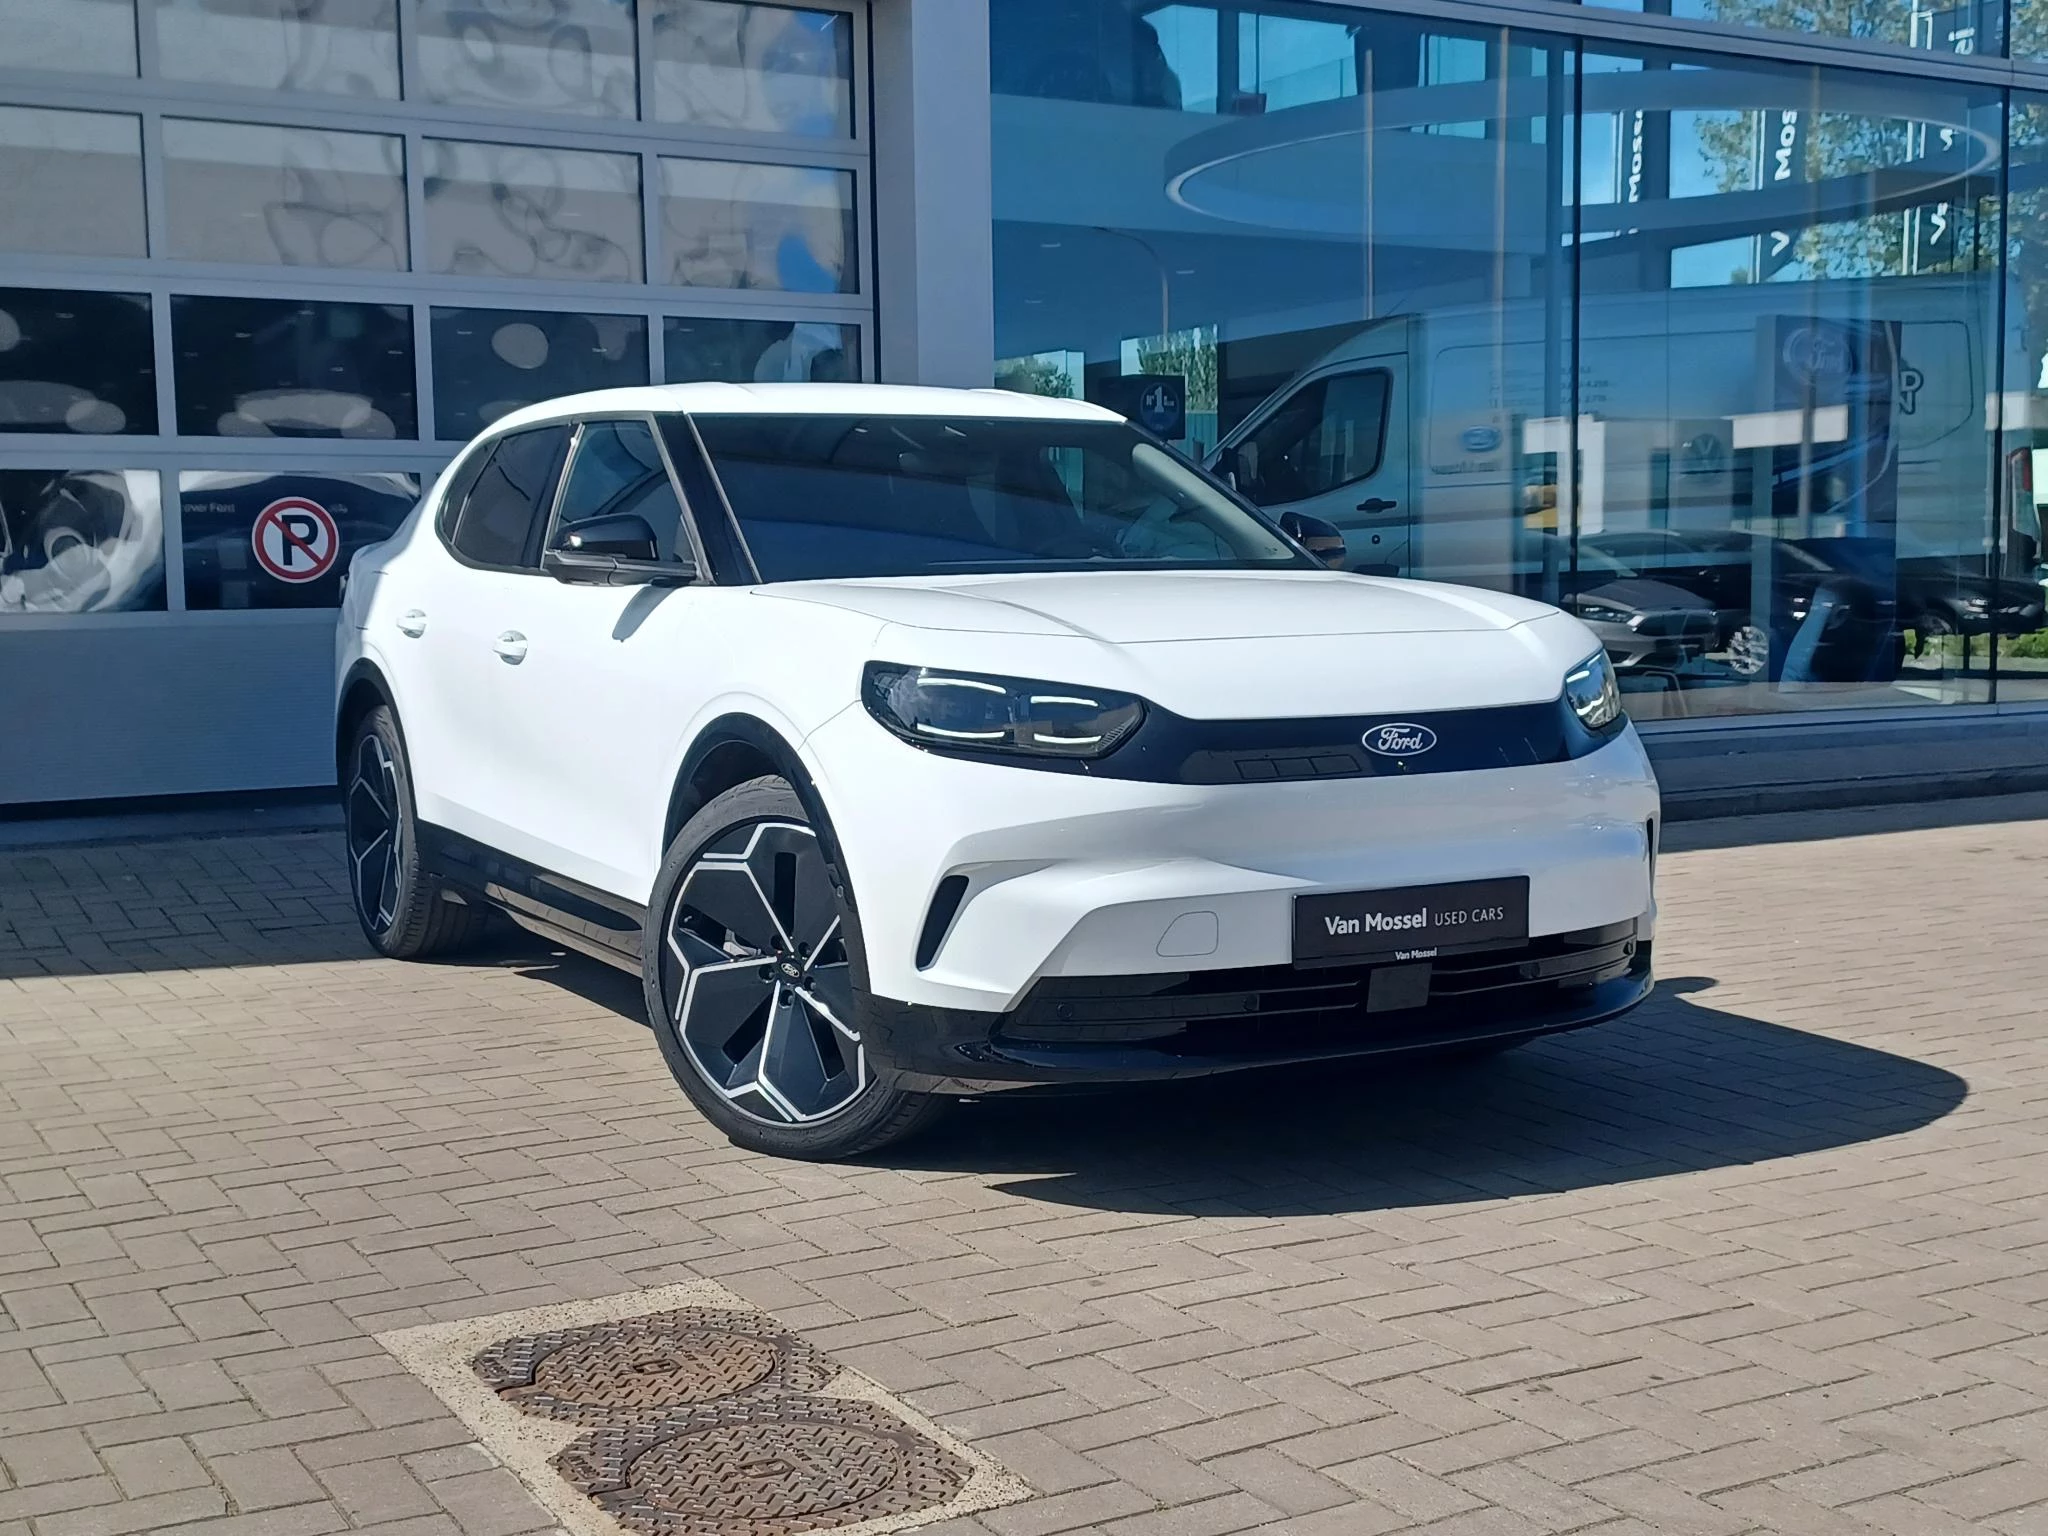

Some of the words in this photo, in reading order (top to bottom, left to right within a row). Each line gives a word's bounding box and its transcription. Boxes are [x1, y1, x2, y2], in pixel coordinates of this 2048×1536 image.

[281, 514, 319, 566] P
[1378, 727, 1423, 750] Ford
[1324, 916, 1360, 936] Van
[1365, 907, 1427, 932] Mossel
[1434, 911, 1468, 926] USED
[1472, 906, 1504, 922] CARS
[1395, 950, 1410, 960] Van
[1411, 947, 1438, 959] Mossel
